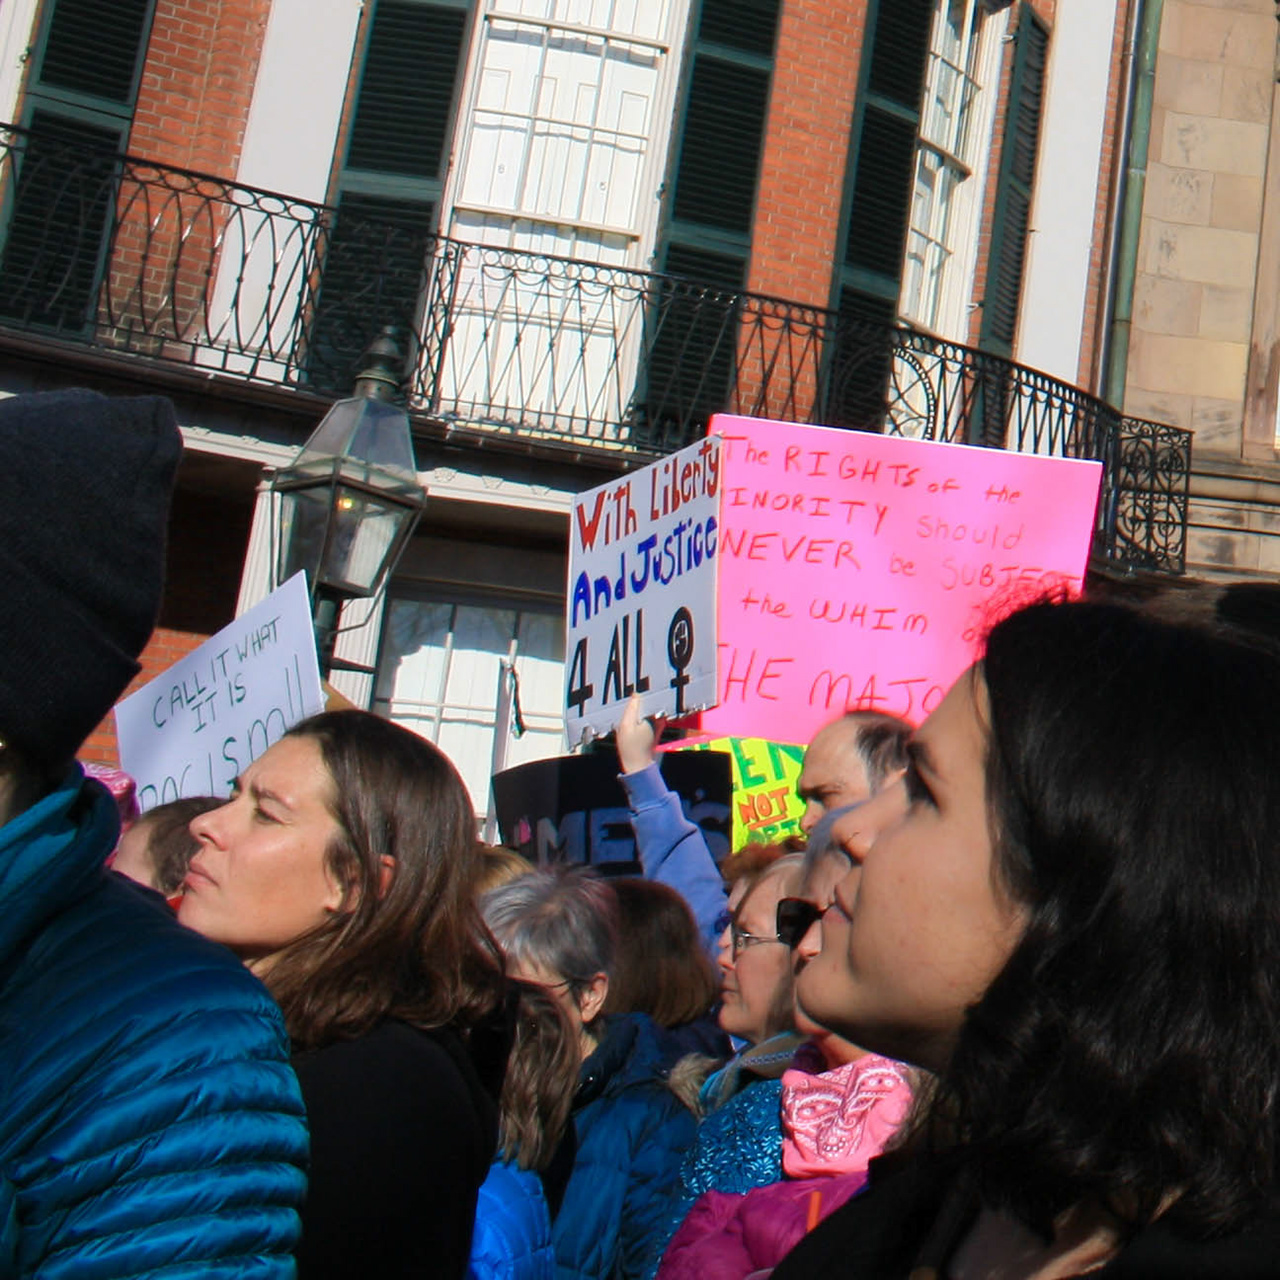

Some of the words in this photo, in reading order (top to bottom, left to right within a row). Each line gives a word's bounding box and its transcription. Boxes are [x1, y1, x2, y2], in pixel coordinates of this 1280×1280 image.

[576, 481, 638, 554] With
[650, 440, 720, 521] Liberty
[784, 445, 922, 488] RIGHTS
[984, 483, 1021, 506] the
[719, 486, 888, 535] INORITY
[720, 528, 861, 570] NEVER
[742, 589, 793, 618] the
[153, 671, 207, 728] CALL
[211, 648, 230, 683] IT
[235, 616, 282, 662] WHAT
[567, 636, 593, 718] 4
[602, 608, 650, 706] ALL
[809, 669, 946, 719] MAJO
[737, 786, 790, 825] NOT
